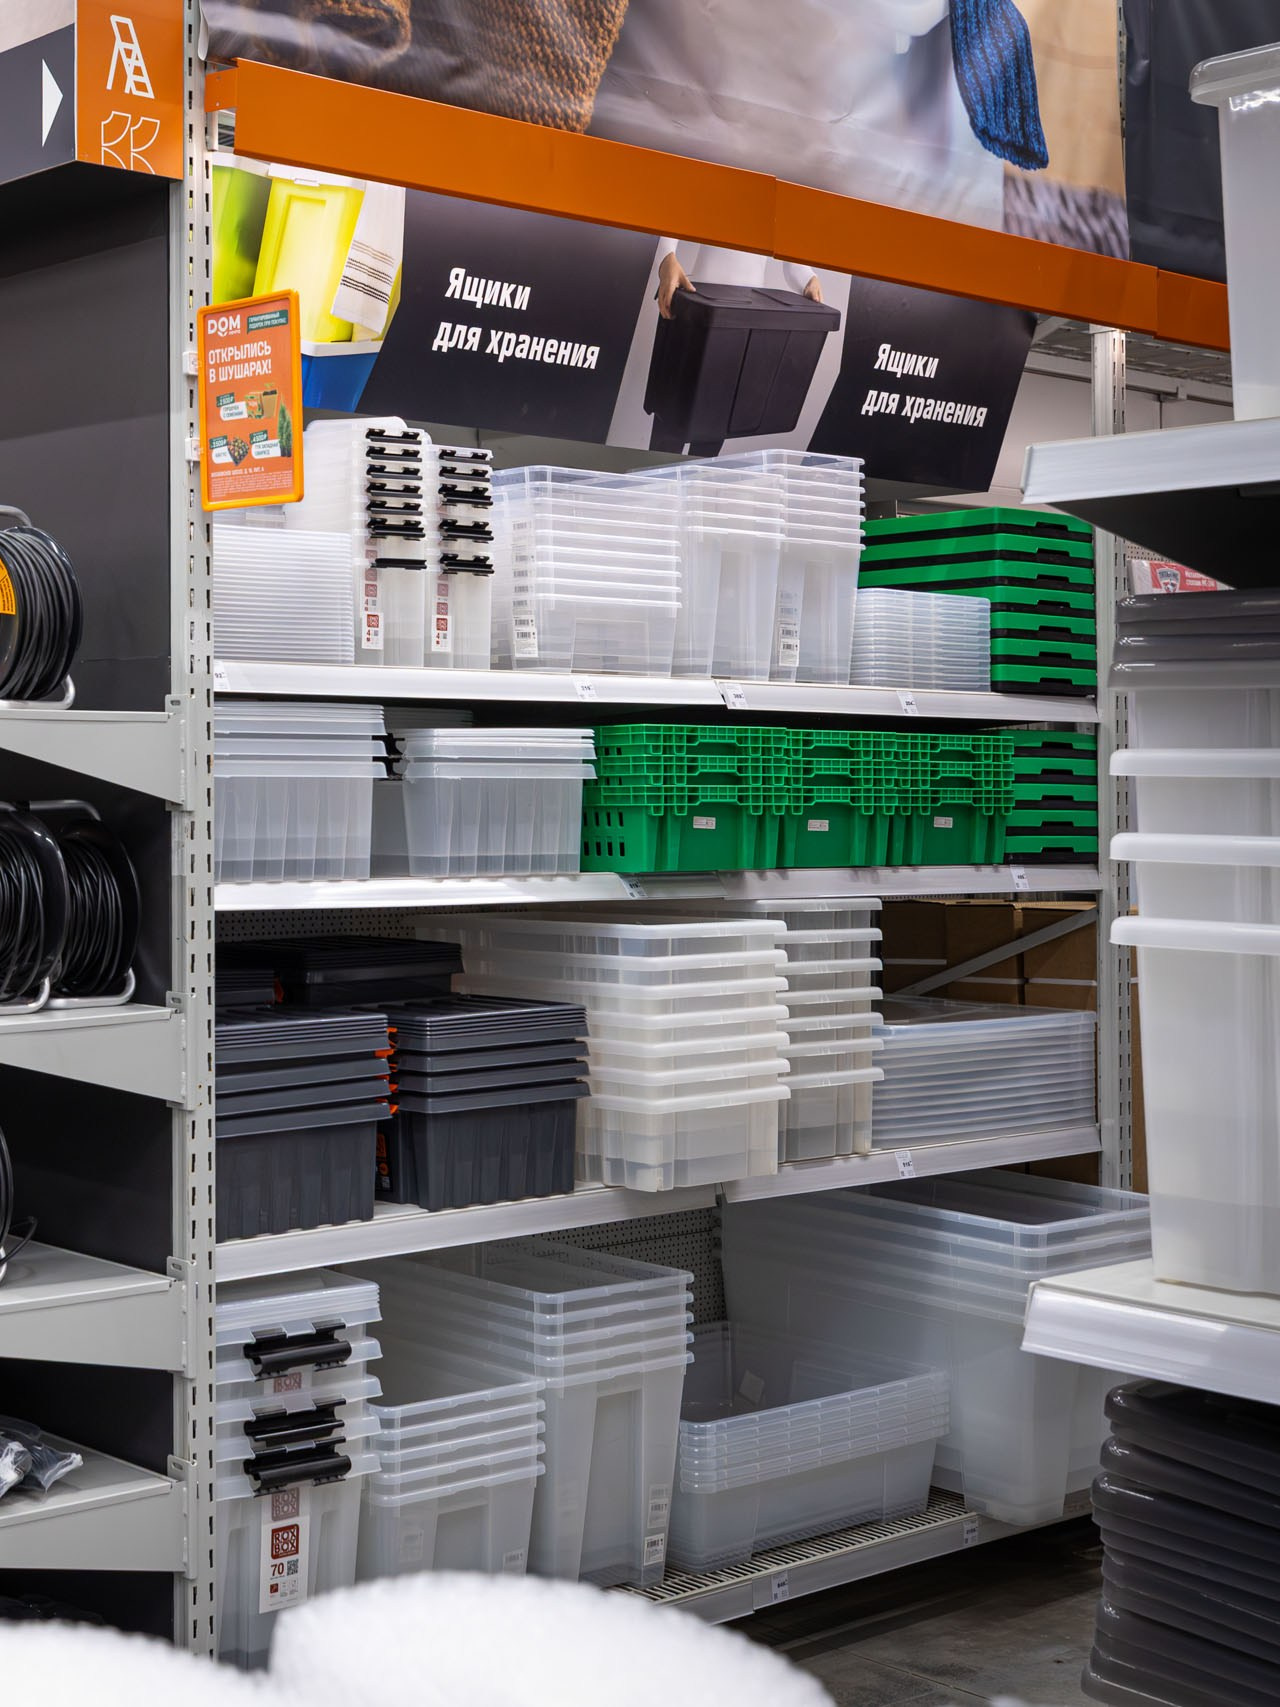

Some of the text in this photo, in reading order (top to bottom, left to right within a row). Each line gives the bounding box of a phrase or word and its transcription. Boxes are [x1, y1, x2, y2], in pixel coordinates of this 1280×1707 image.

[443, 267, 532, 311] Ящики
[208, 341, 272, 365] ОТКРЫЛИСЬ
[432, 320, 601, 371] для хранения
[209, 358, 272, 383] В ШУШАРАХ!
[873, 342, 940, 380] Ящики
[861, 388, 989, 429] для хранения
[273, 1490, 297, 1506] ROX
[273, 1501, 298, 1517] BOX
[273, 1529, 297, 1545] ROX
[273, 1540, 297, 1555] BOX
[270, 1561, 285, 1577] 70
